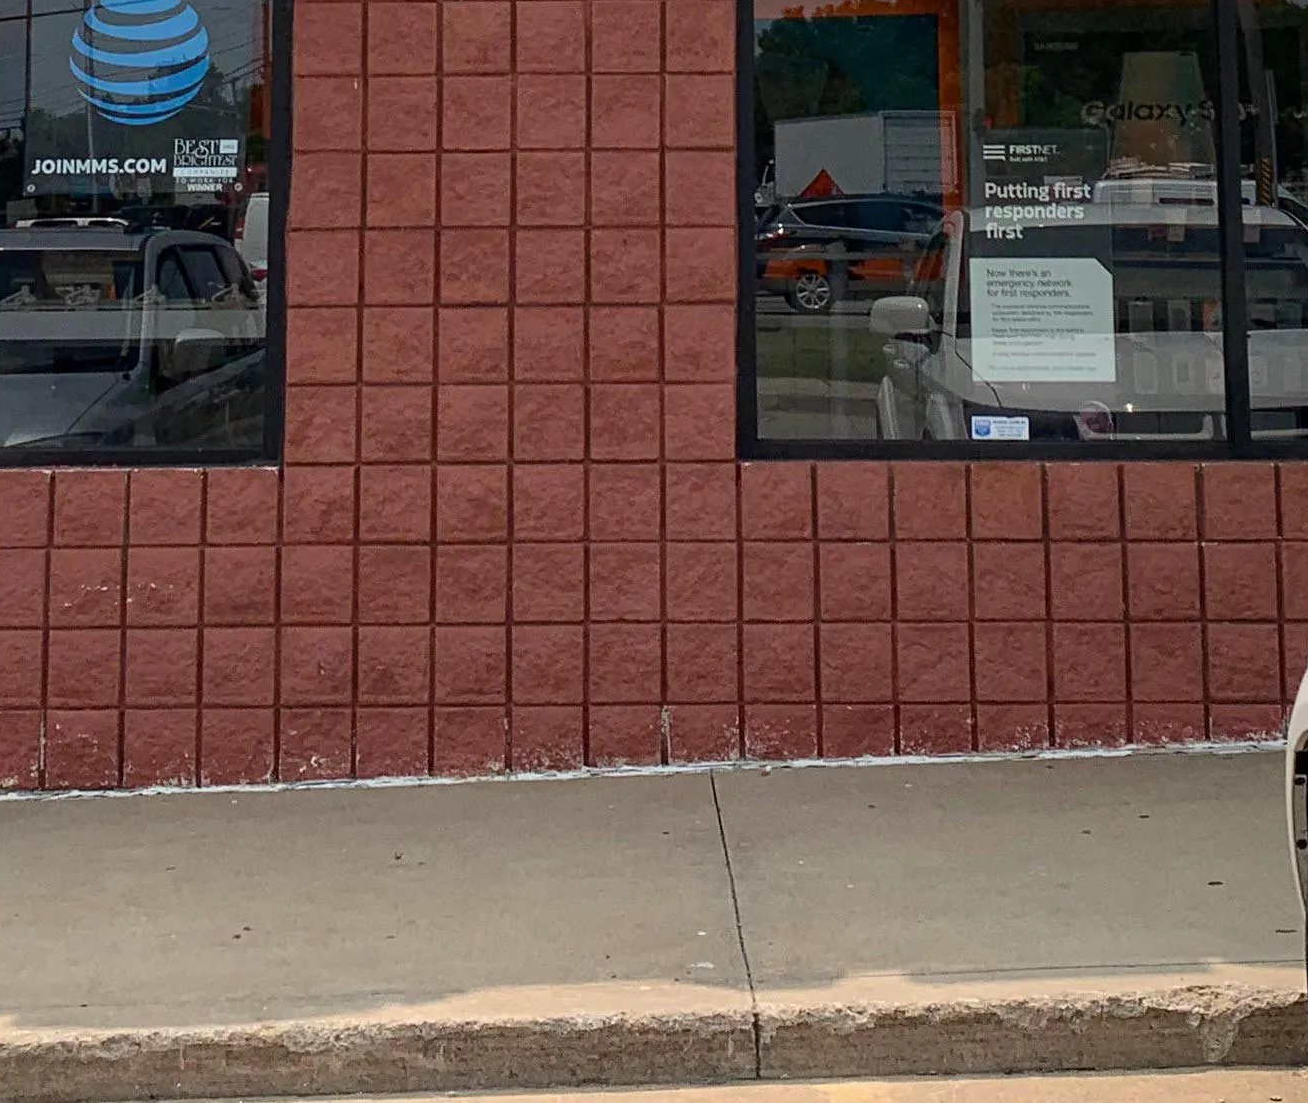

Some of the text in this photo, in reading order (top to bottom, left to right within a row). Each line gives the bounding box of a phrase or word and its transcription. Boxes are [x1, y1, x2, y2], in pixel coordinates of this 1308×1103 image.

[31, 157, 167, 175] JOINMMS.COM
[187, 184, 224, 192] WINNER
[984, 182, 1091, 202] Putting first
[984, 203, 1086, 221] responders
[984, 222, 1024, 239] first
[986, 269, 1007, 277] Now
[1008, 268, 1038, 277] there's
[986, 279, 1072, 289] emergency network
[986, 289, 999, 297] for
